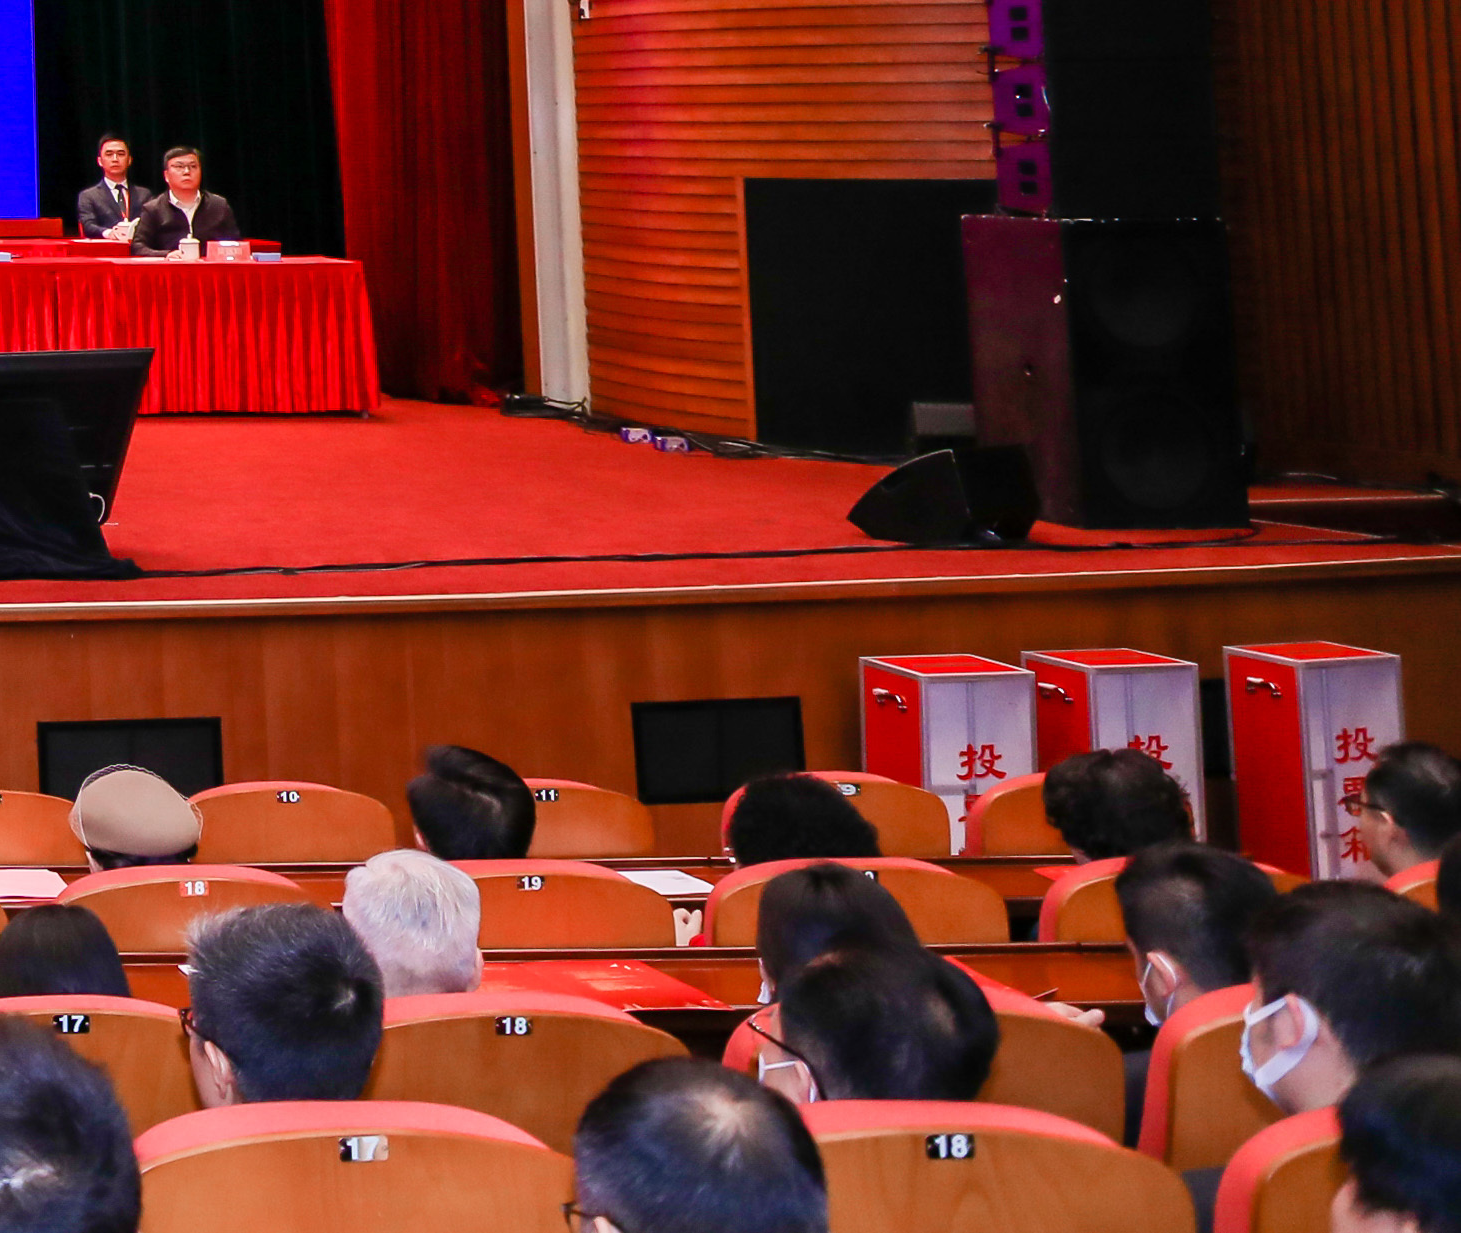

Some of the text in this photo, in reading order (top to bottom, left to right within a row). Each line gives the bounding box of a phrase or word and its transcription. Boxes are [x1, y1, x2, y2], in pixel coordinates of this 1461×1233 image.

[280, 791, 298, 803] 10
[541, 790, 556, 801] 11
[184, 881, 206, 896] 18
[521, 875, 541, 891] 19
[58, 1015, 85, 1033] 17
[502, 1017, 528, 1035] 18
[346, 1137, 380, 1161] 17
[934, 1134, 968, 1158] 18
